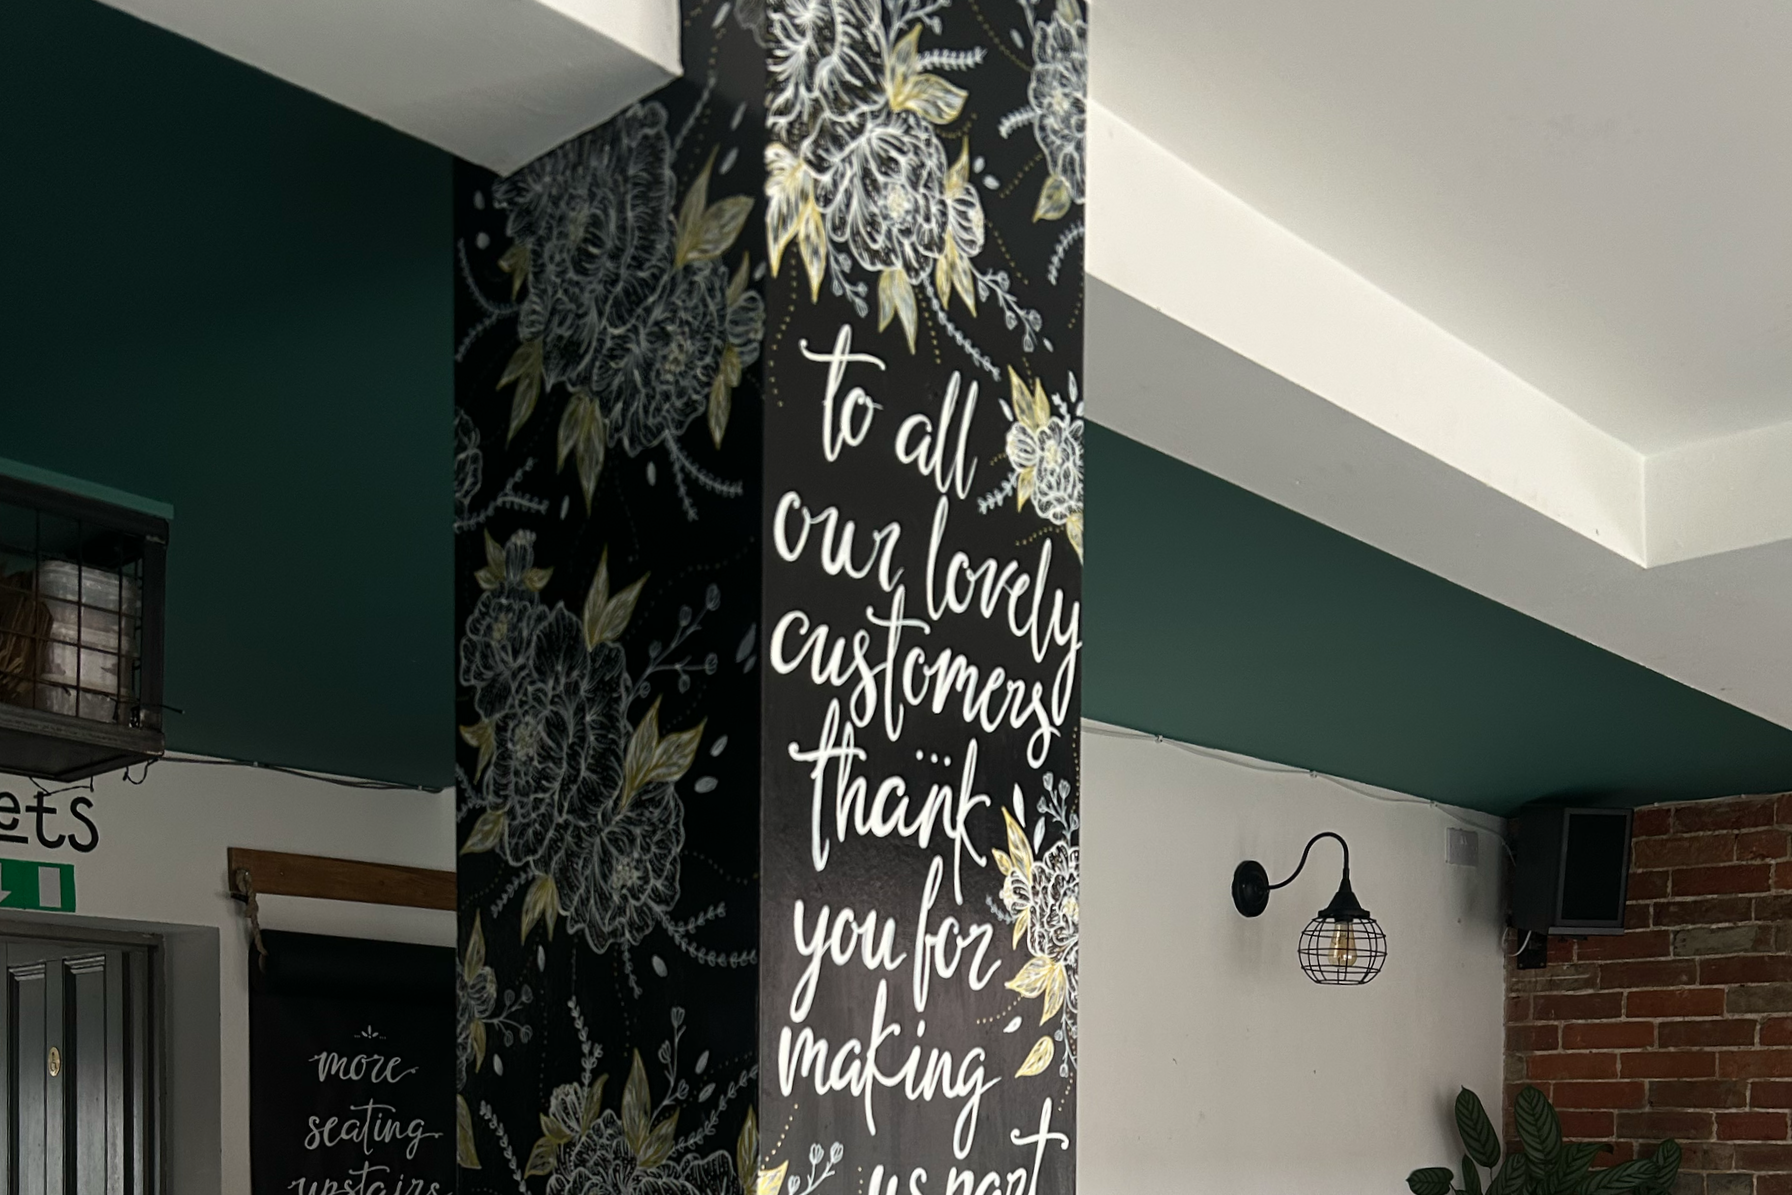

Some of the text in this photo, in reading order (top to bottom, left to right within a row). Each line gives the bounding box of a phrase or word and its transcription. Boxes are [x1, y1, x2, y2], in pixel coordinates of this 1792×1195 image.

[799, 323, 979, 500] to all
[769, 583, 1062, 770] customers
[773, 490, 1083, 727] our lovely
[787, 697, 992, 906] thank
[789, 854, 1002, 1024] you for
[303, 1097, 445, 1161] seating
[307, 1050, 419, 1084] more
[777, 978, 1003, 1160] making
